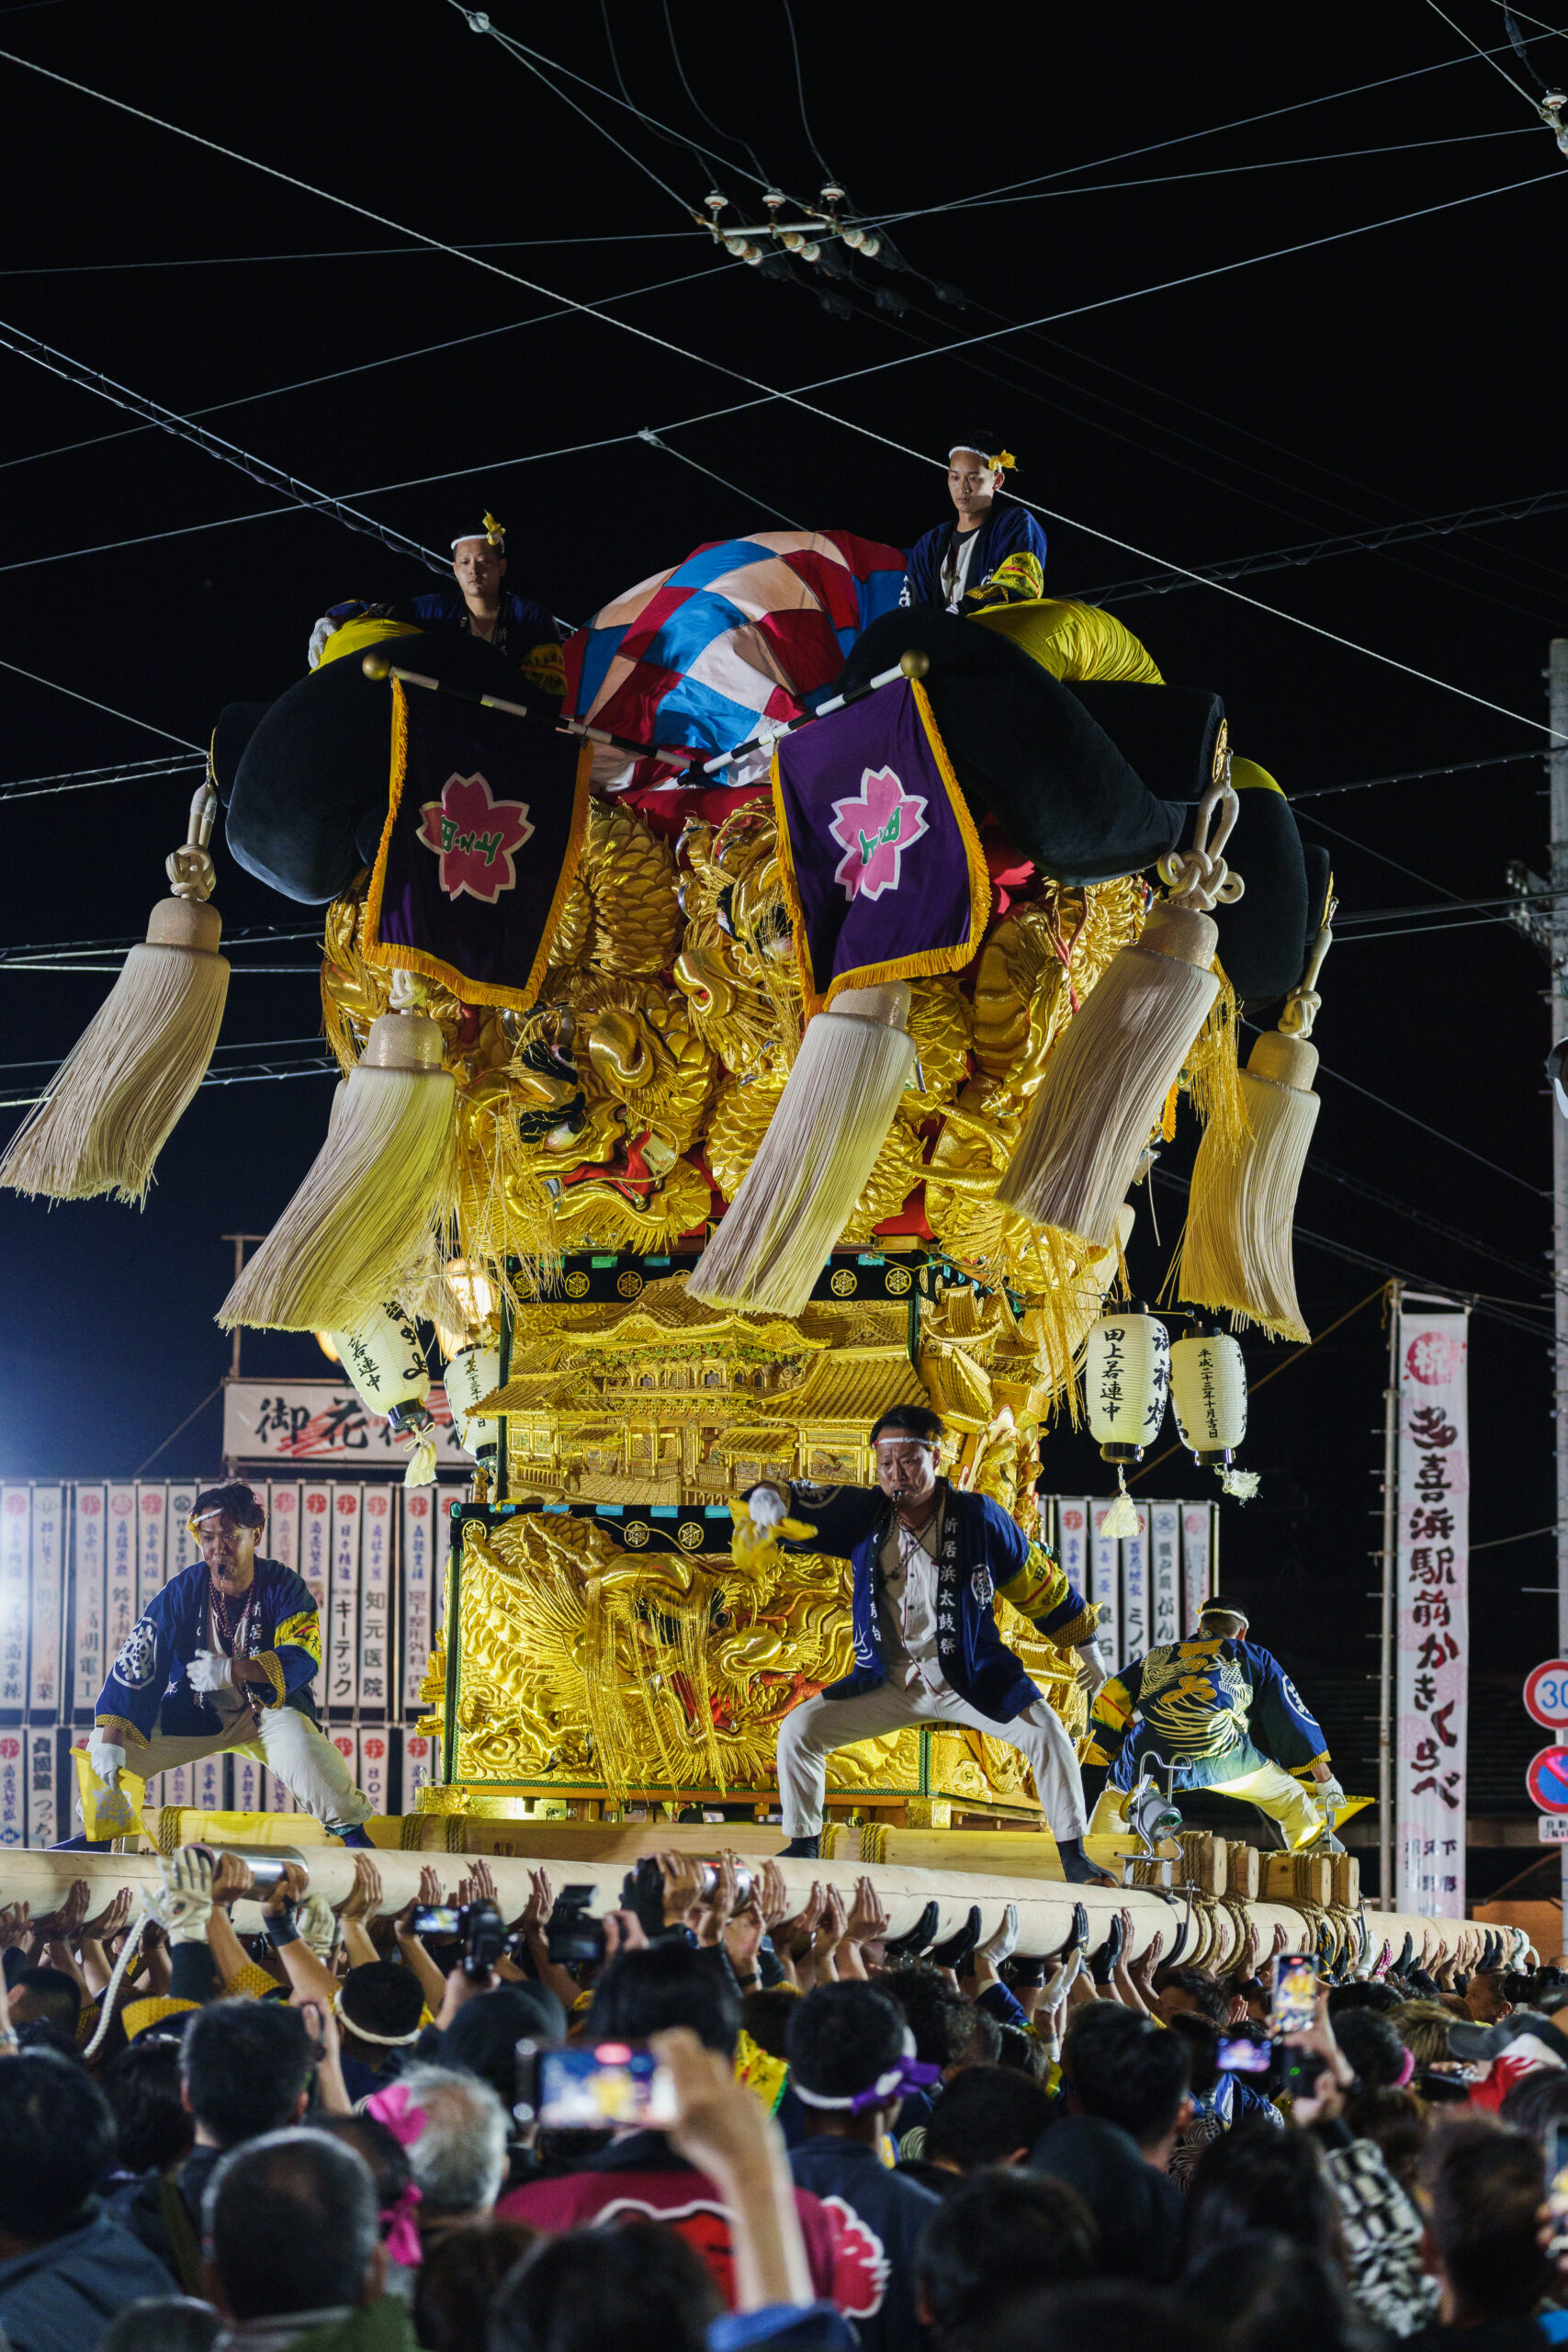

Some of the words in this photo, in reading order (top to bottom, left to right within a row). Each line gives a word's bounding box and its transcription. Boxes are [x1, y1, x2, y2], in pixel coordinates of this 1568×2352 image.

[463, 1359, 487, 1429] 平成二十三年十日
[1100, 1329, 1125, 1423] 田上若連中
[1198, 1349, 1219, 1439] 平成二十三年十月吉日
[333, 1599, 352, 1698] キーテック
[363, 1590, 386, 1698] 知元医院
[1408, 1406, 1461, 1810] 多喜浜駅前かきくらべ
